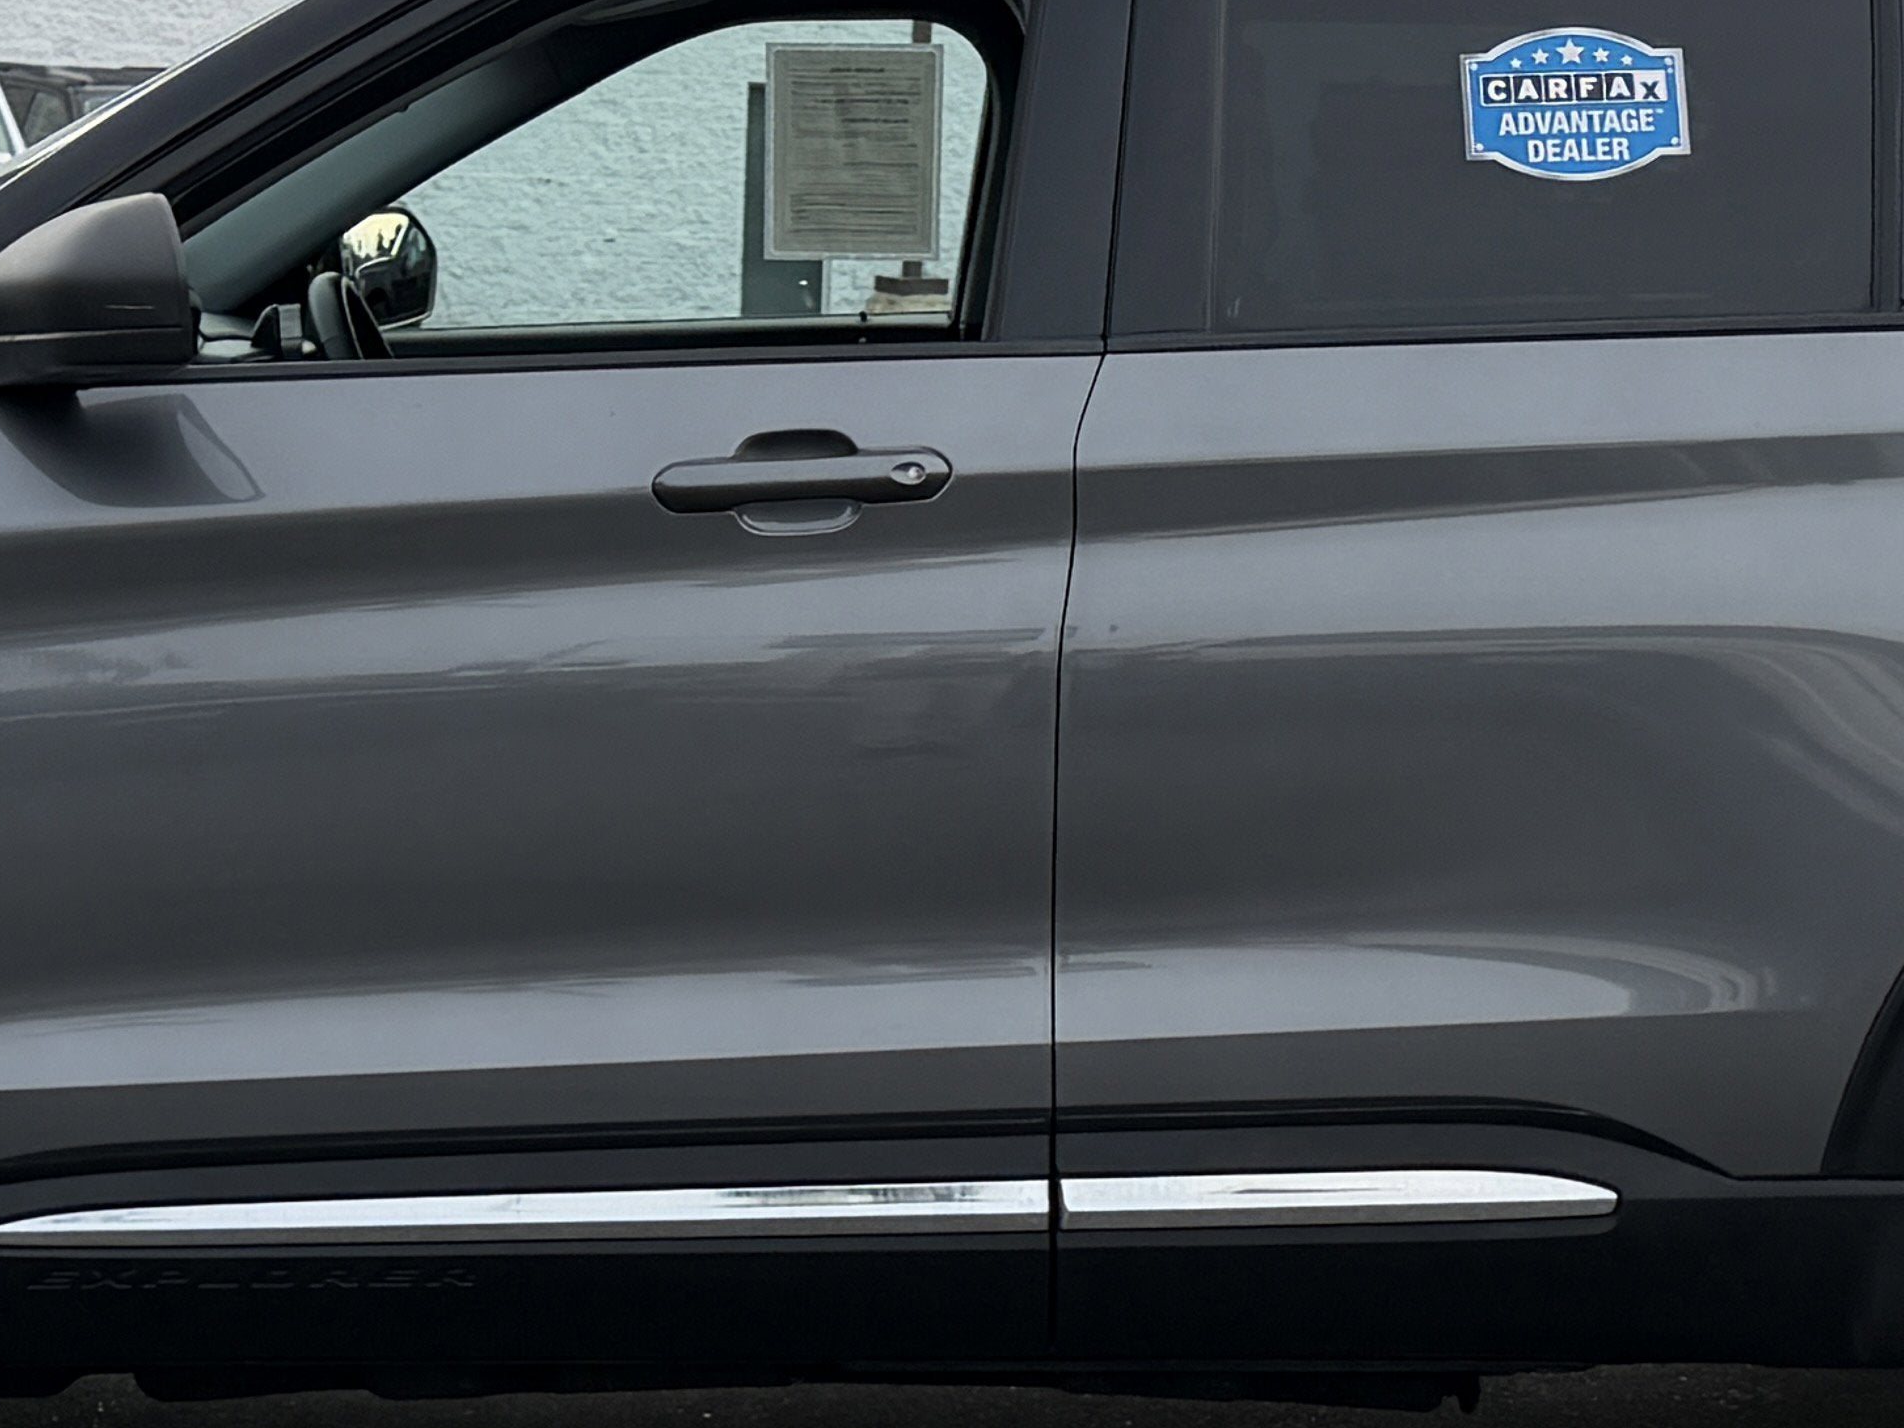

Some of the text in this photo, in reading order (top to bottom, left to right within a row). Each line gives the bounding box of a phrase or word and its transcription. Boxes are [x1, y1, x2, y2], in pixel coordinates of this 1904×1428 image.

[1484, 74, 1663, 103] CARFAX
[1499, 109, 1655, 137] ADVANTAGE
[1527, 137, 1630, 163] DEALER
[25, 1268, 476, 1290] EXPLORER
